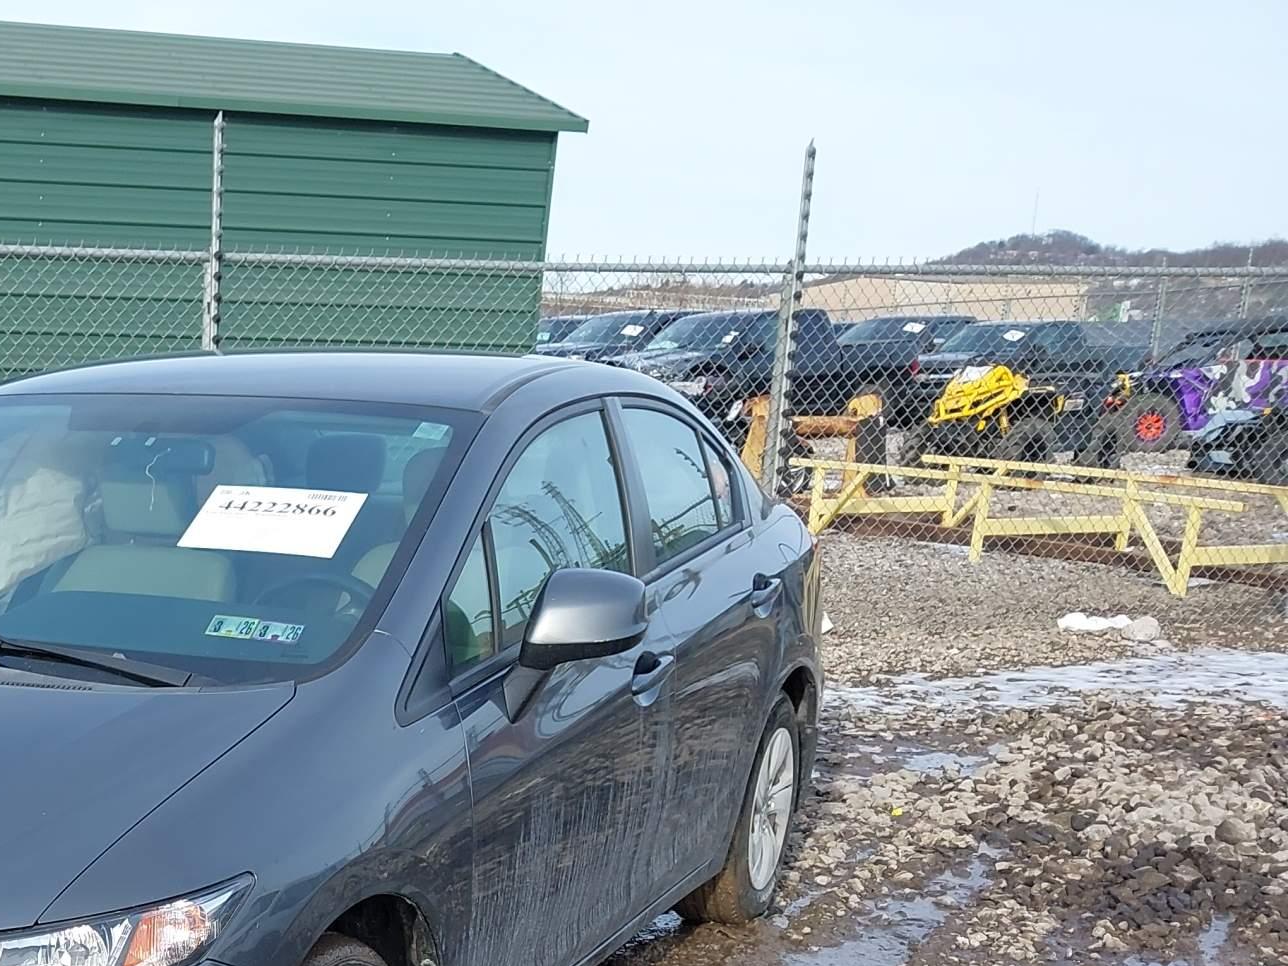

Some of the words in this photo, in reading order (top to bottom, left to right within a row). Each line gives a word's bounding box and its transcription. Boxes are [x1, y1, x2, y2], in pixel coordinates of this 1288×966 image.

[218, 500, 337, 517] 44222866
[213, 620, 223, 632] 3
[259, 625, 270, 637] 3
